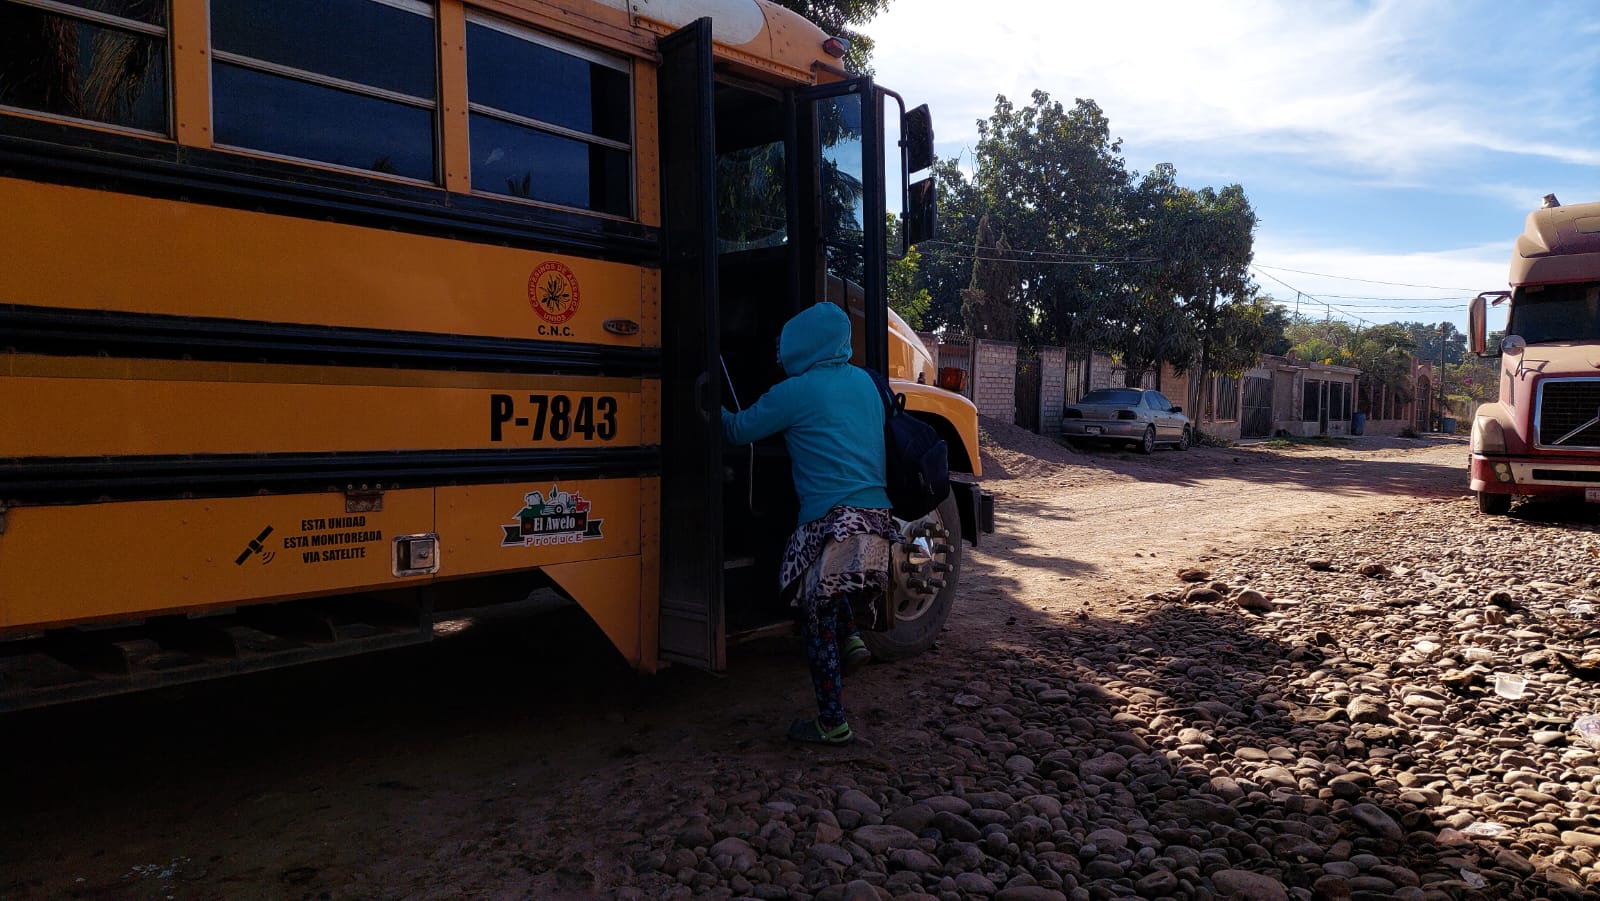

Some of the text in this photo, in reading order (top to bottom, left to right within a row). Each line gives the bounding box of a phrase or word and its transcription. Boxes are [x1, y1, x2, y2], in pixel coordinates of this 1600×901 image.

[537, 325, 575, 337] C.N.C.
[490, 393, 618, 441] P-7843
[301, 515, 366, 531] ESTA UNIDAD
[534, 516, 575, 531] El Awelo
[284, 530, 382, 549] ESTA MONITOREADA
[302, 547, 366, 563] VIA SATELITE
